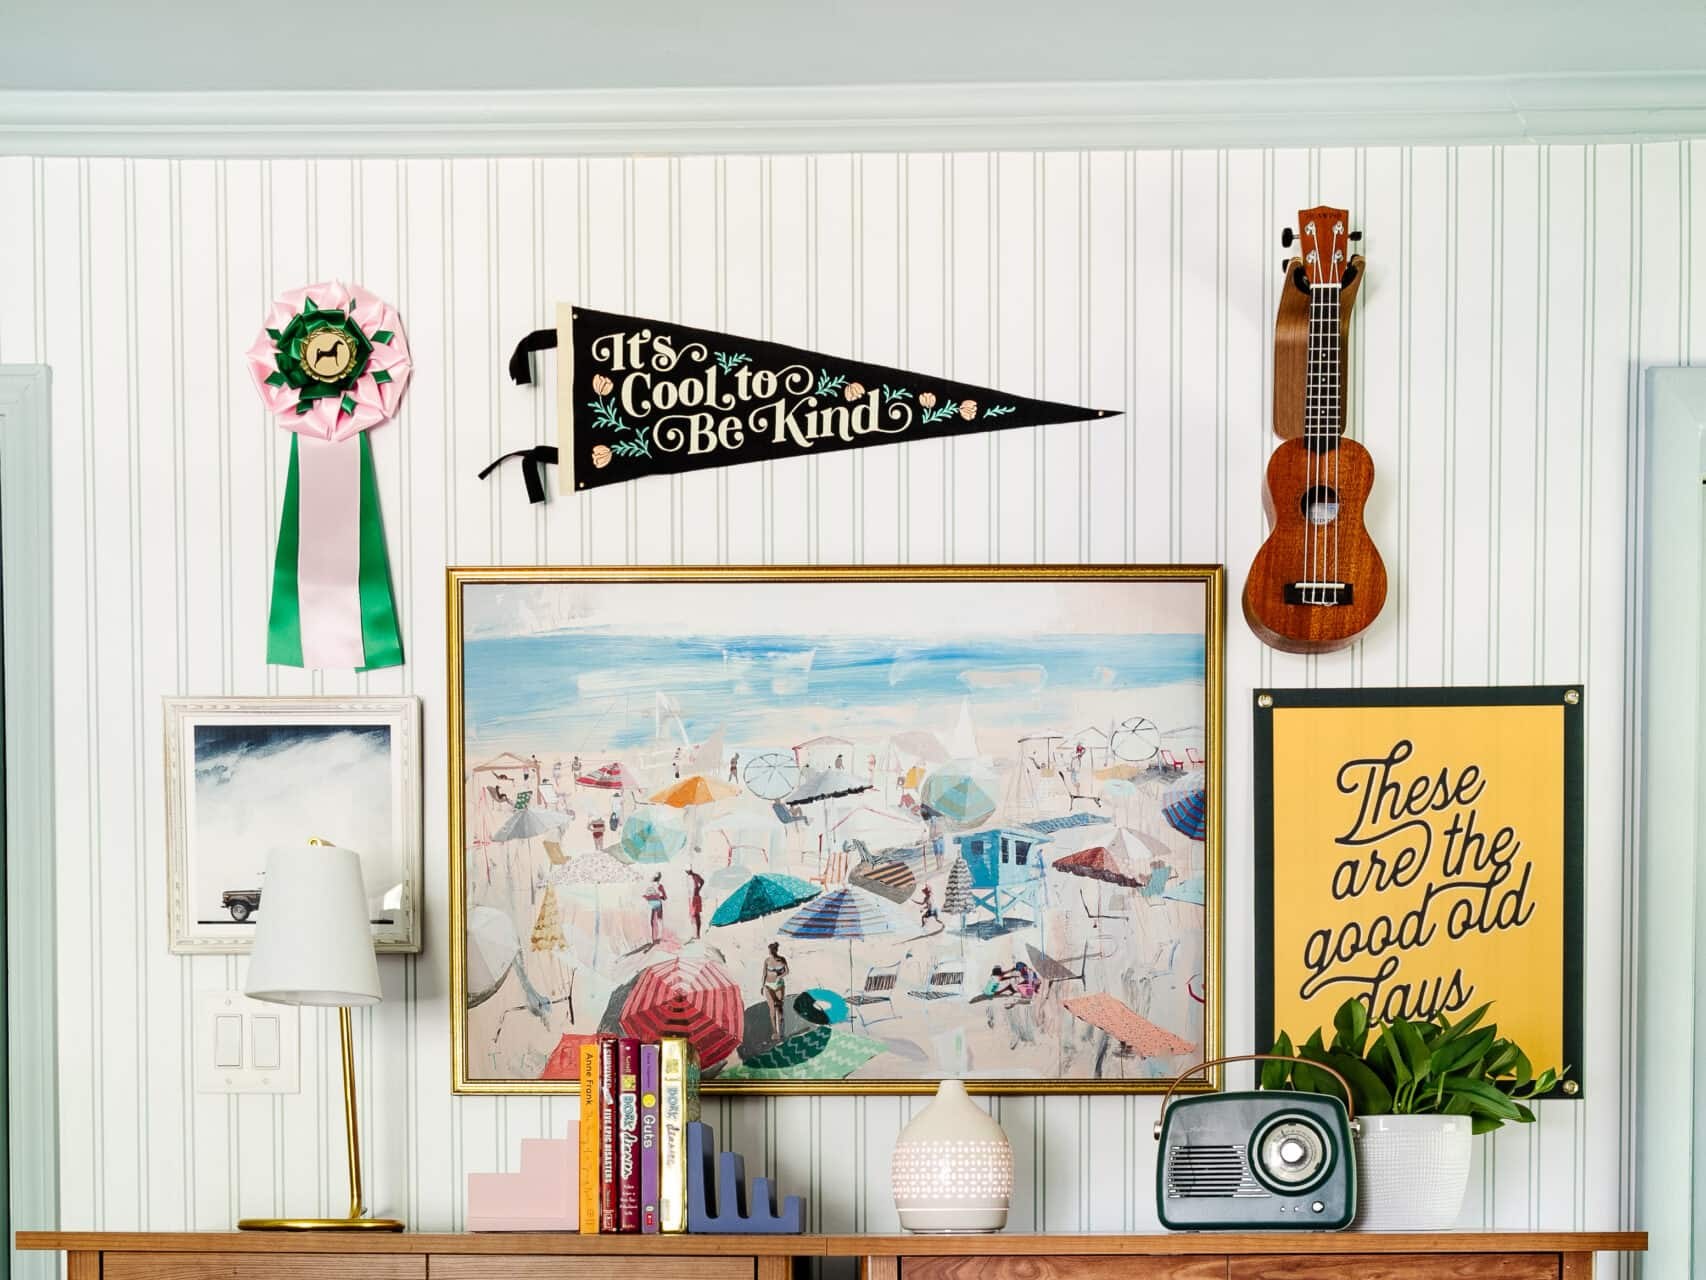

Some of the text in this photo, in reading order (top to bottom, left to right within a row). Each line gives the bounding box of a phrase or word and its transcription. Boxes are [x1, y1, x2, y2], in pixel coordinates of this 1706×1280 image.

[591, 327, 708, 372] It's
[620, 364, 814, 418] Cool to
[653, 388, 913, 455] Be Kind
[1335, 739, 1487, 845] These
[1332, 810, 1521, 900] are the
[1301, 861, 1536, 997] good old
[1340, 956, 1474, 1028] days
[586, 1053, 594, 1077] Anne
[586, 1079, 594, 1105] Frank
[643, 1114, 656, 1149] Guts
